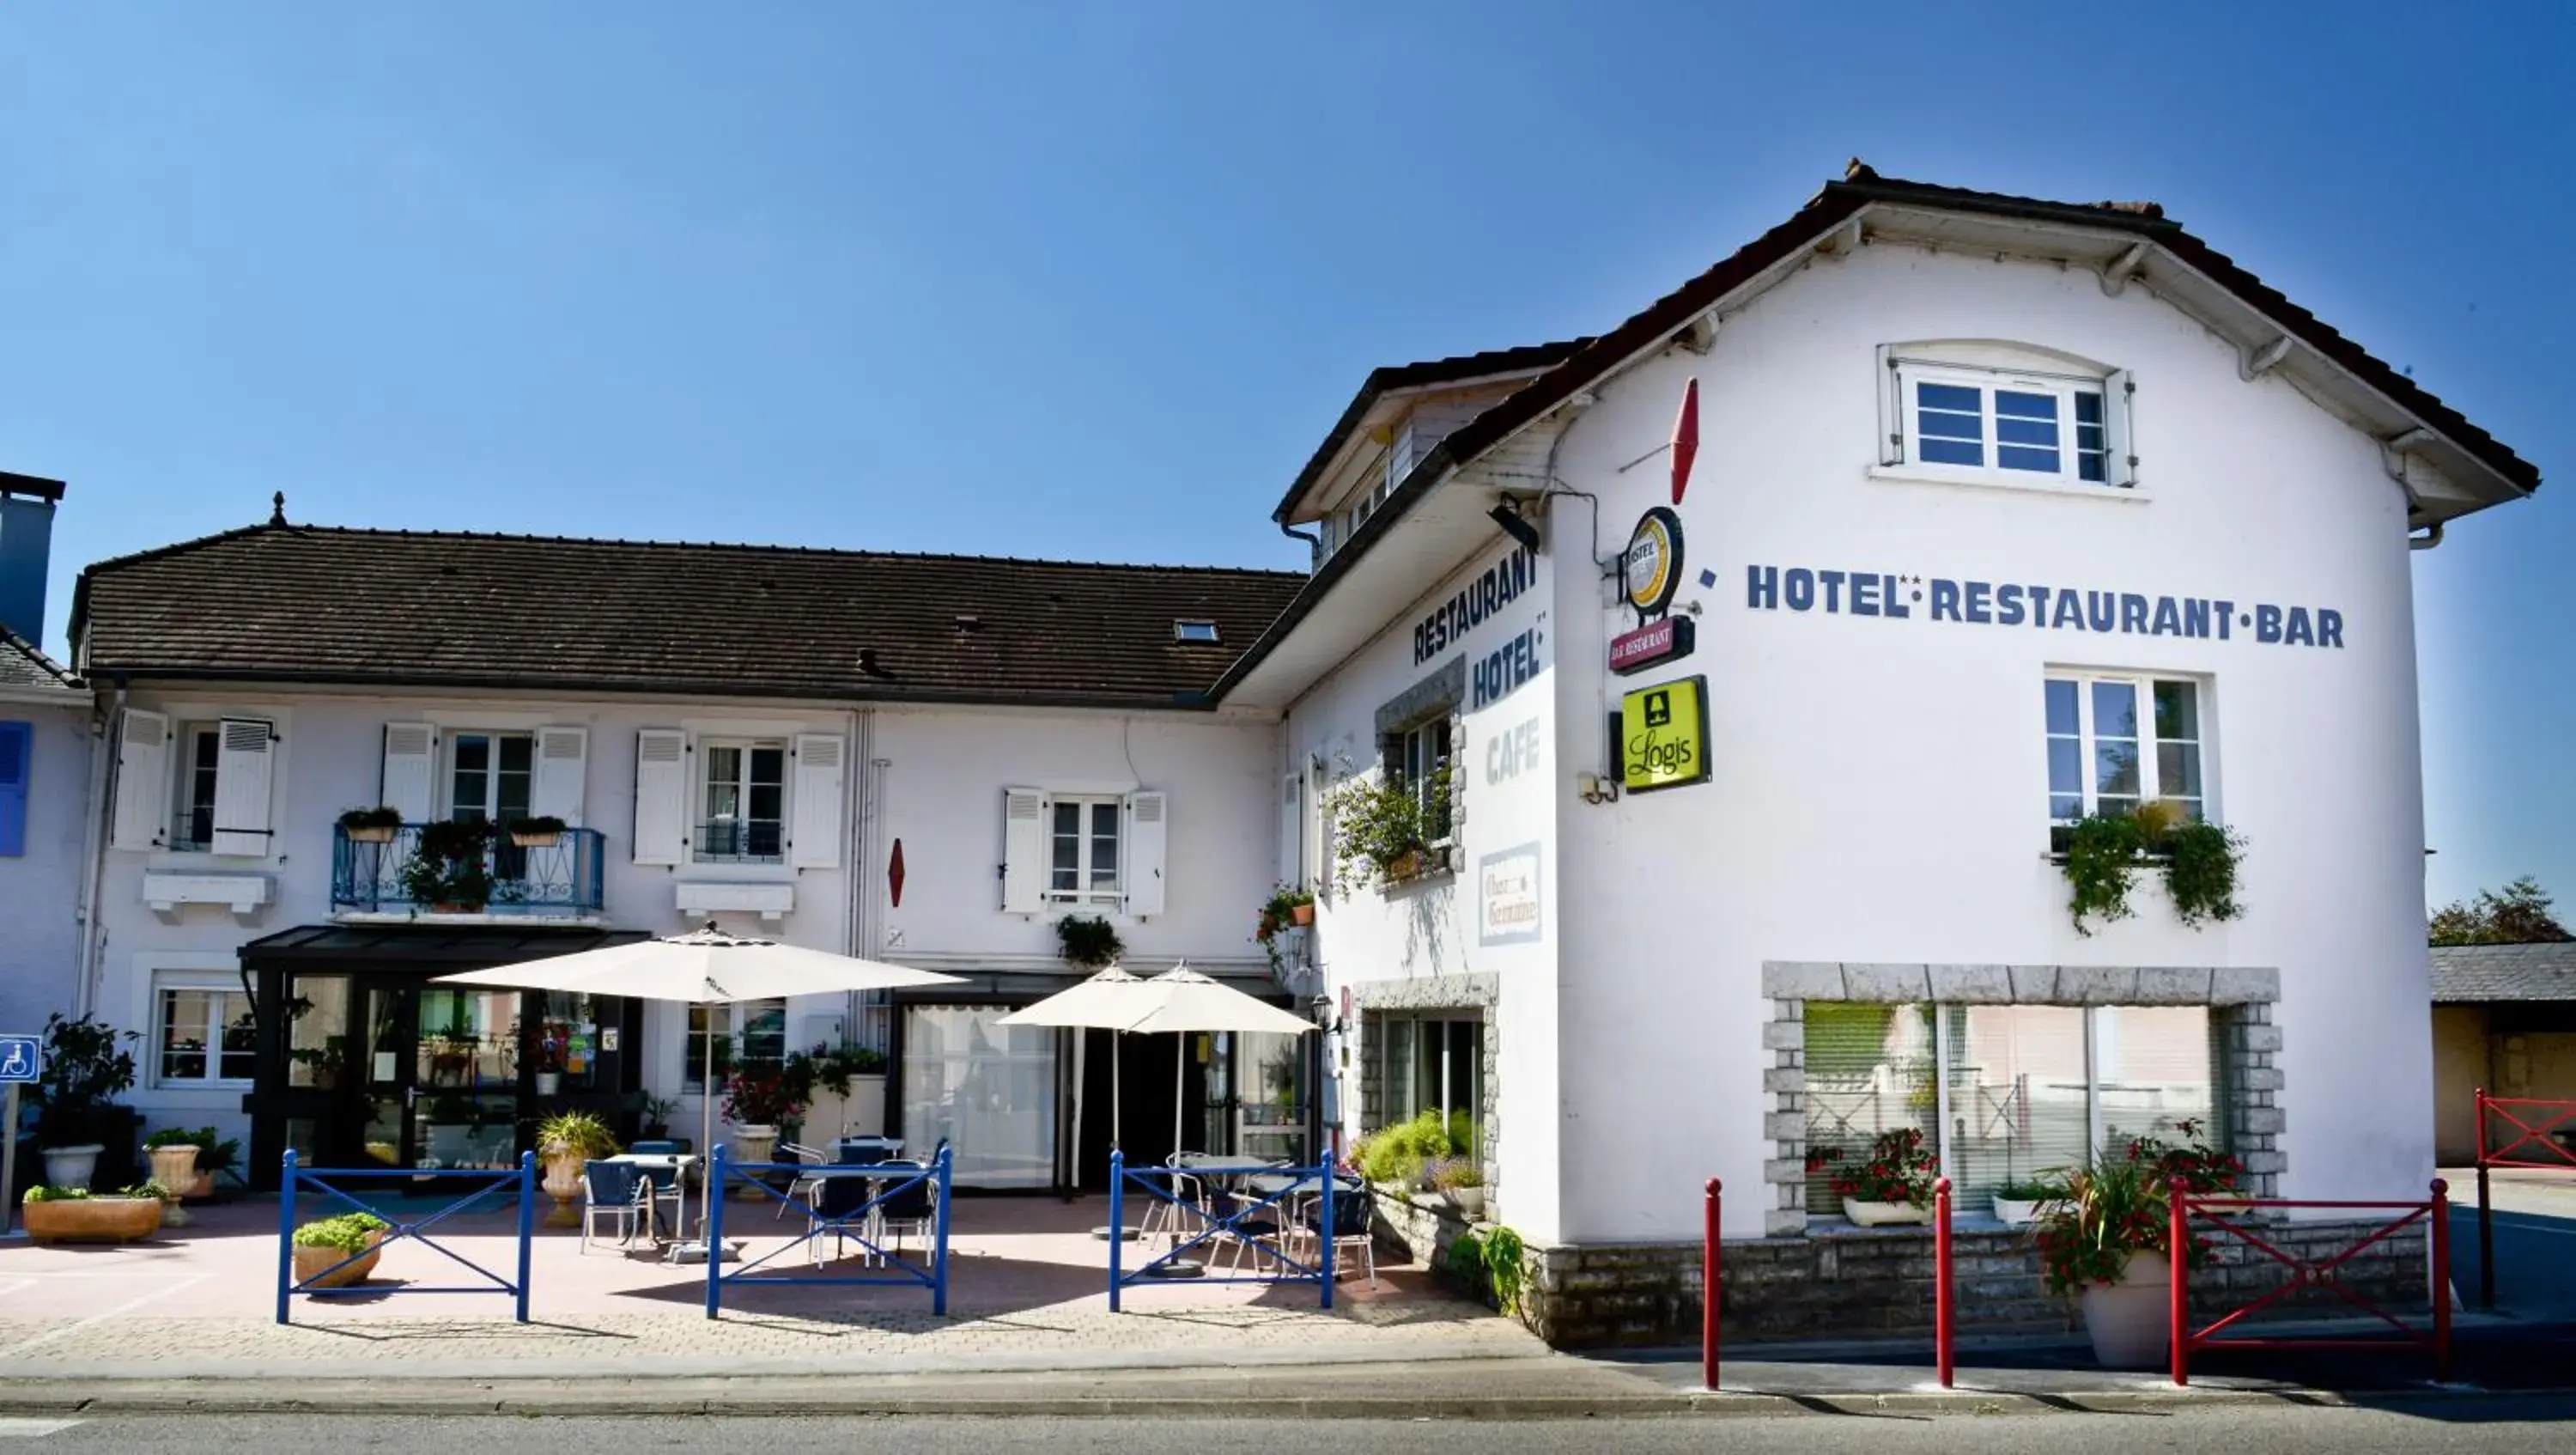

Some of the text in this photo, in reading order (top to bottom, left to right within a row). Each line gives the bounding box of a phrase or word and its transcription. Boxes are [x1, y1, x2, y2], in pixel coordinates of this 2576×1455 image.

[1415, 545, 1536, 667] RESTAURANT
[1625, 628, 1671, 656] RESTAURANT
[1747, 564, 2344, 648] HOTEL RESTAURANT BAR
[1473, 628, 1540, 709] HOTEL
[1627, 728, 1692, 776] Logis
